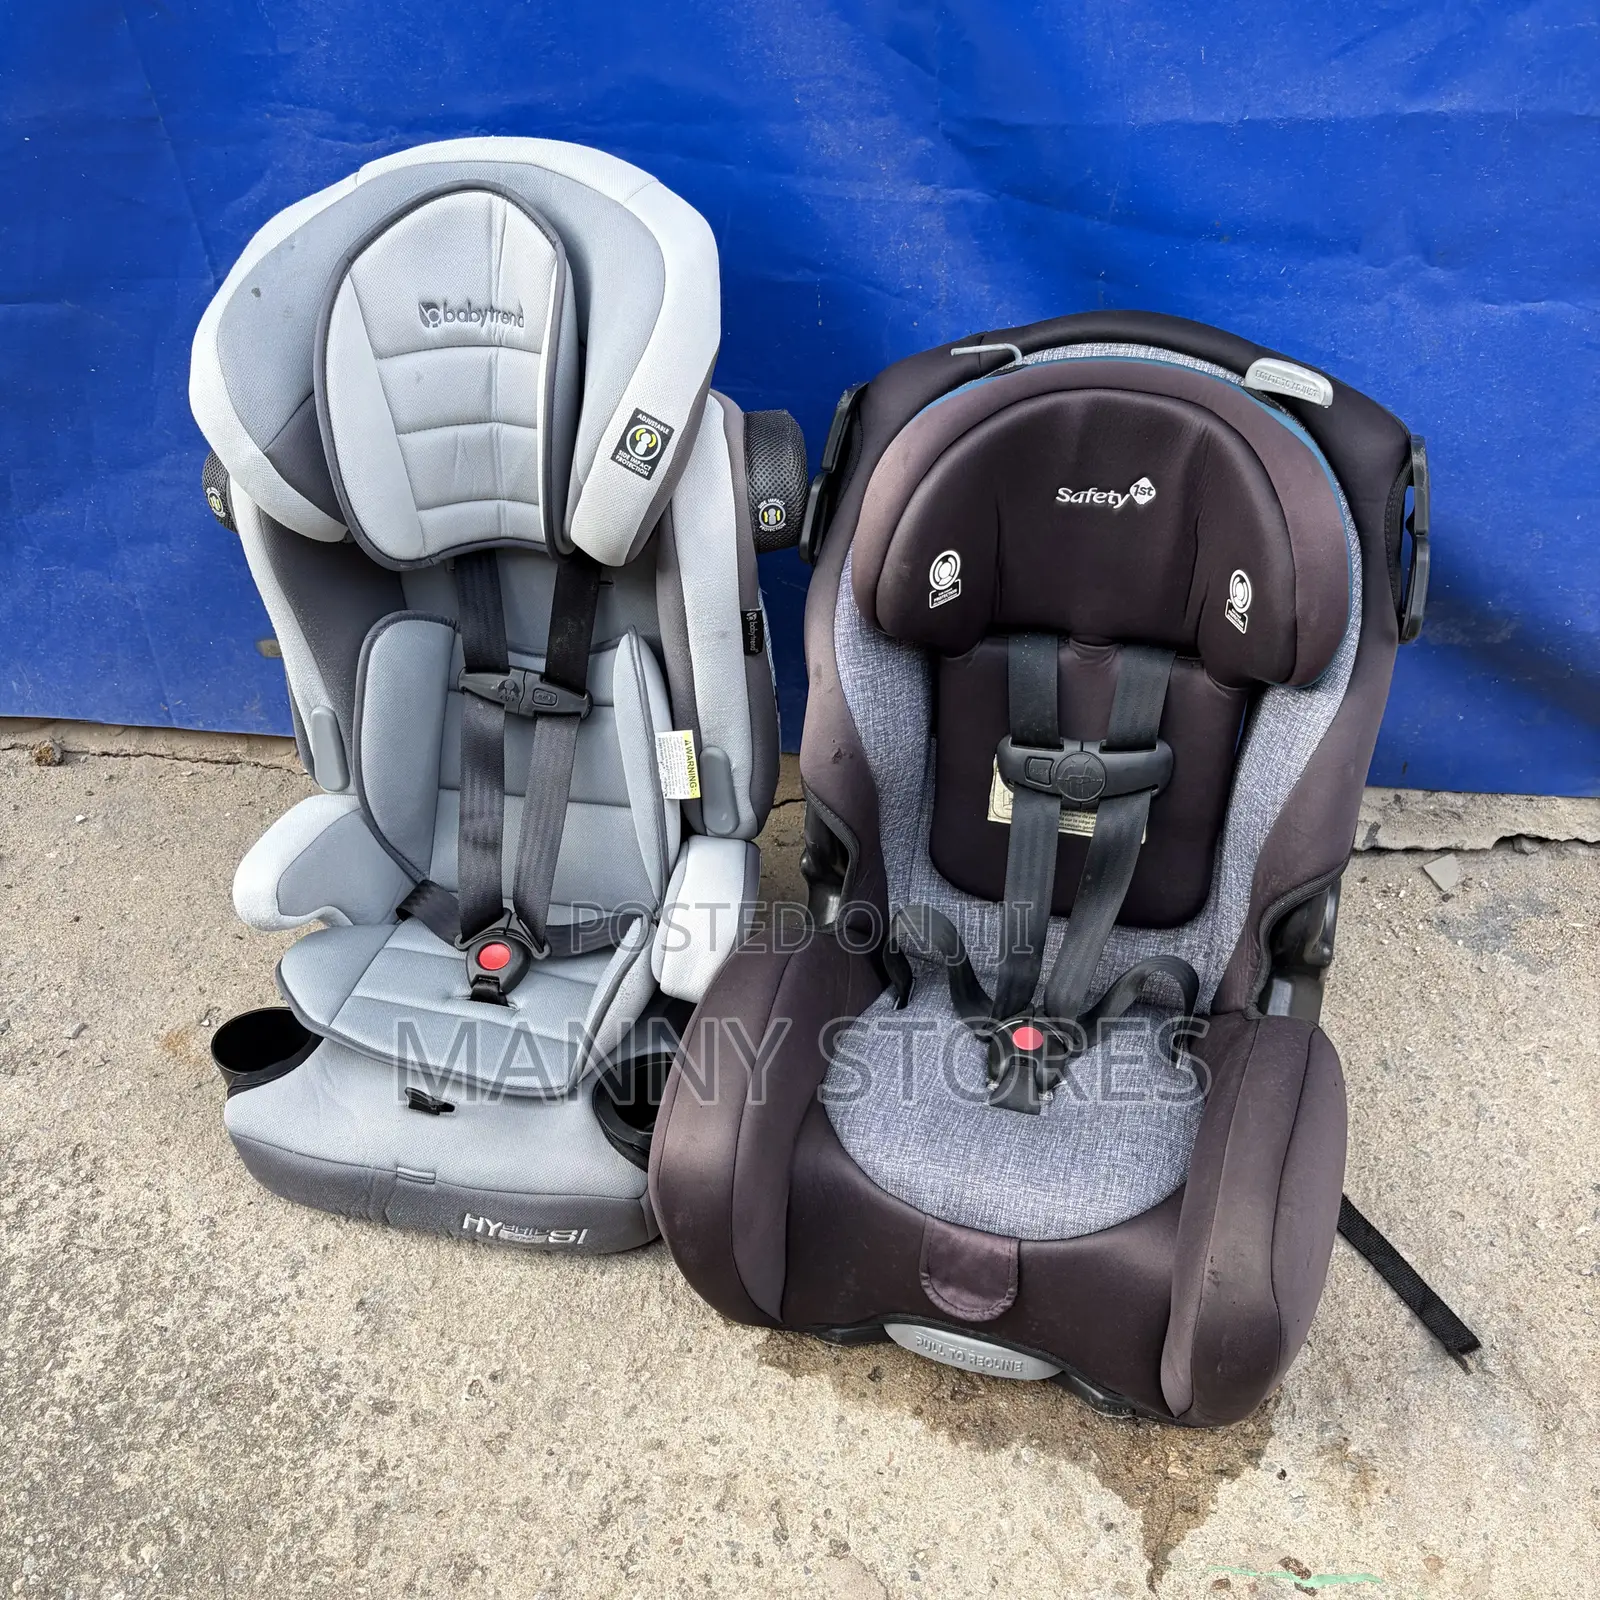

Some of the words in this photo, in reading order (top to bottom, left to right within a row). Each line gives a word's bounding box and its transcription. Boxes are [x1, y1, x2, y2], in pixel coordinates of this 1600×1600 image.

[636, 413, 670, 436] ADJUSTABLE
[615, 454, 650, 477] PROTECTION
[617, 449, 631, 462] SIDE
[629, 456, 652, 472] IMPACT
[1055, 487, 1130, 509] Safety
[1132, 484, 1154, 497] 1st
[915, 1335, 946, 1357] PULL
[949, 1347, 966, 1363] TO
[968, 1352, 1024, 1373] RECLINE
